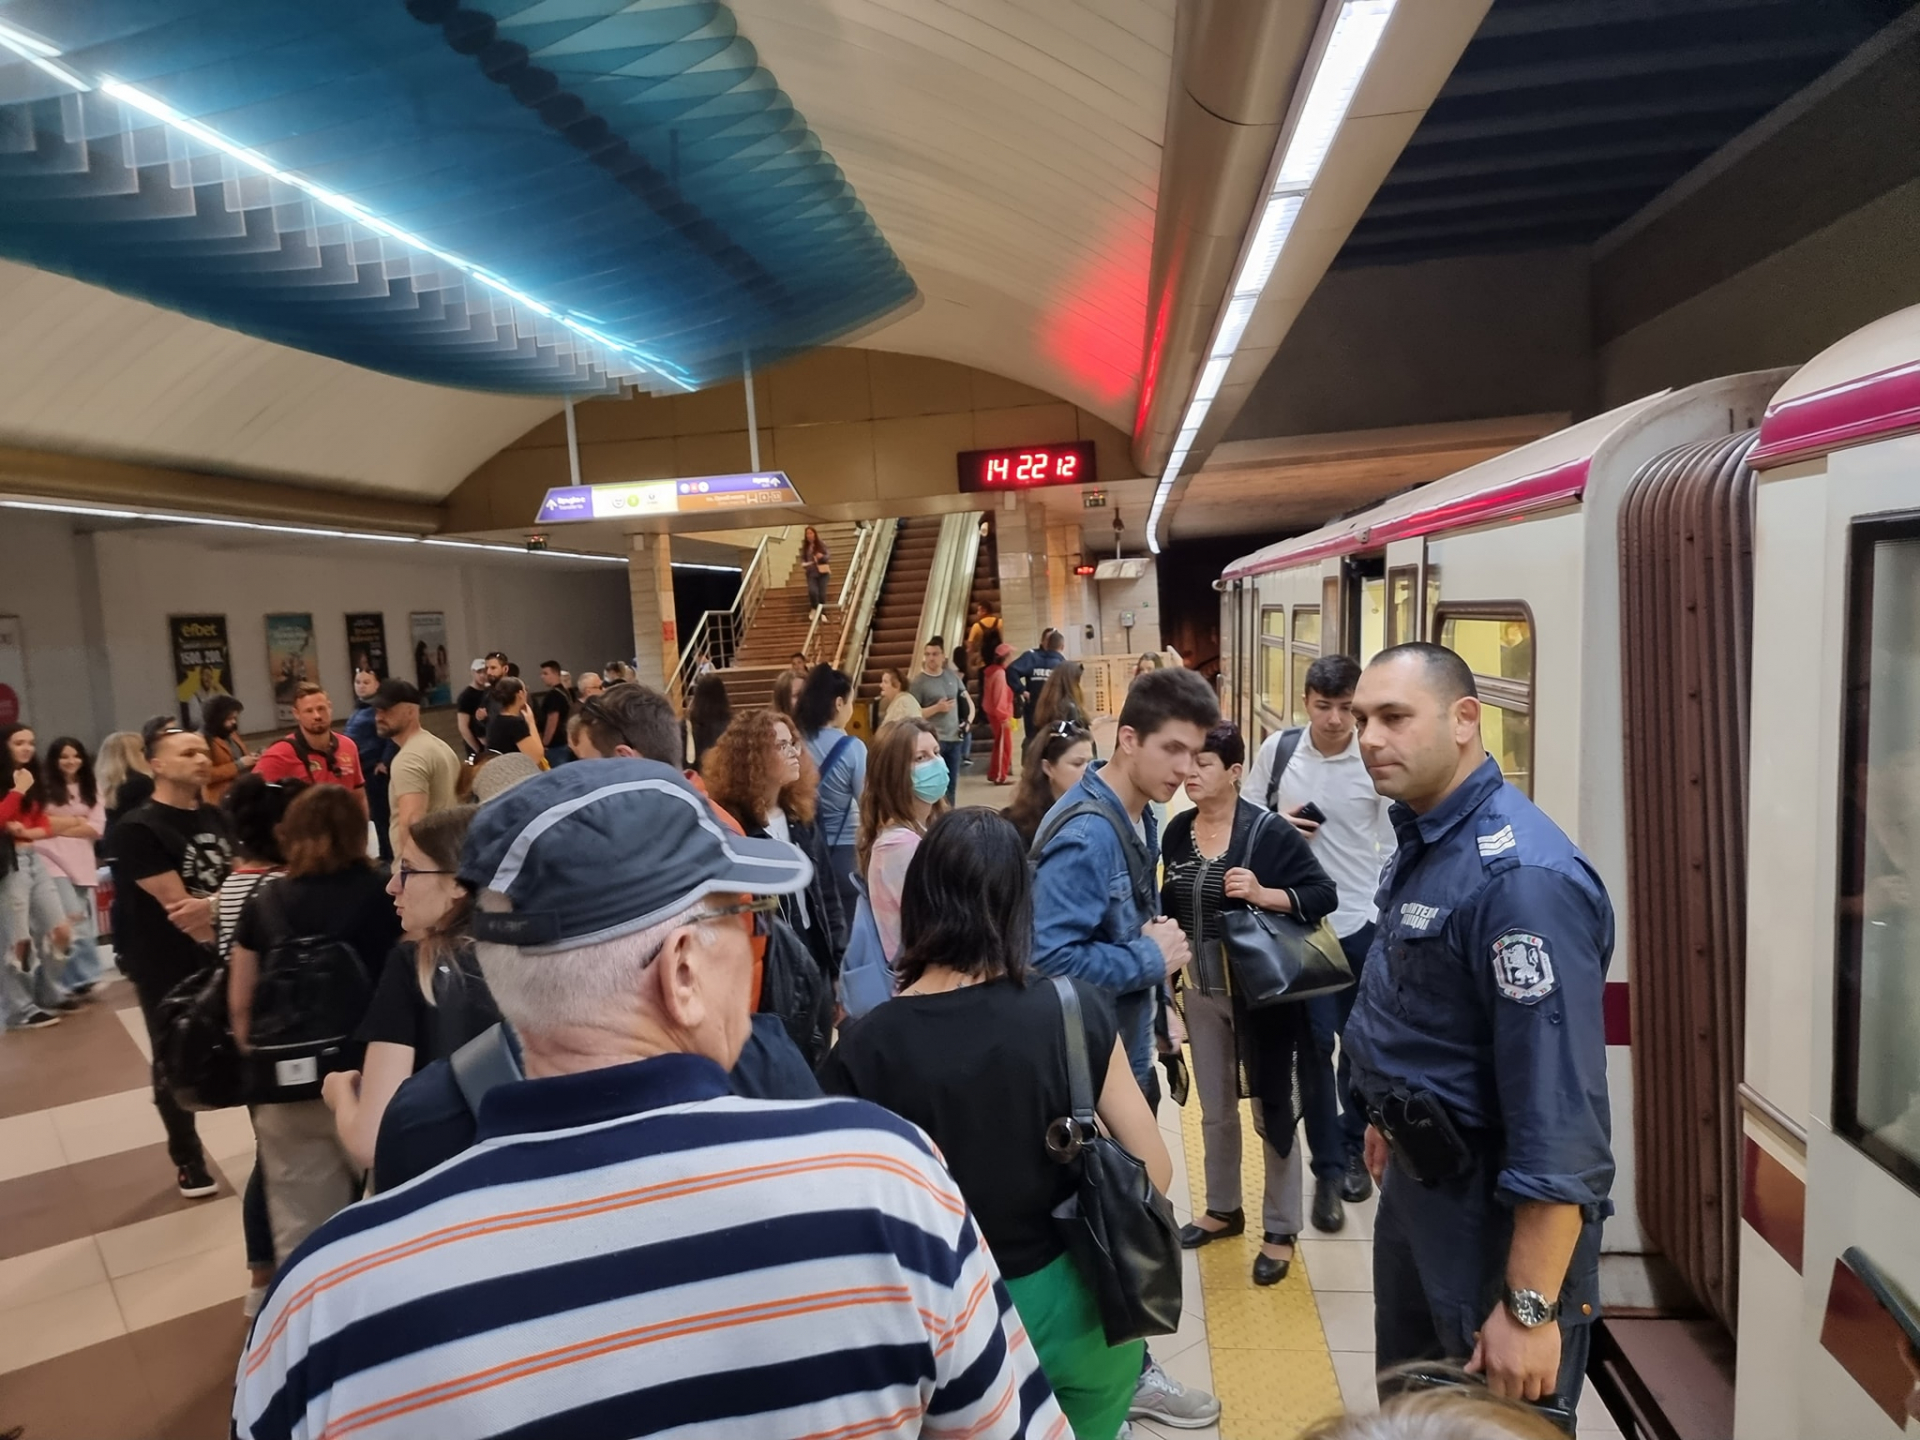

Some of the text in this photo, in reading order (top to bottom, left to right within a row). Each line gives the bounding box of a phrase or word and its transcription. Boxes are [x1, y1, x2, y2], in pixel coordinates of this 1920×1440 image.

[987, 453, 1077, 481] 14 22 12
